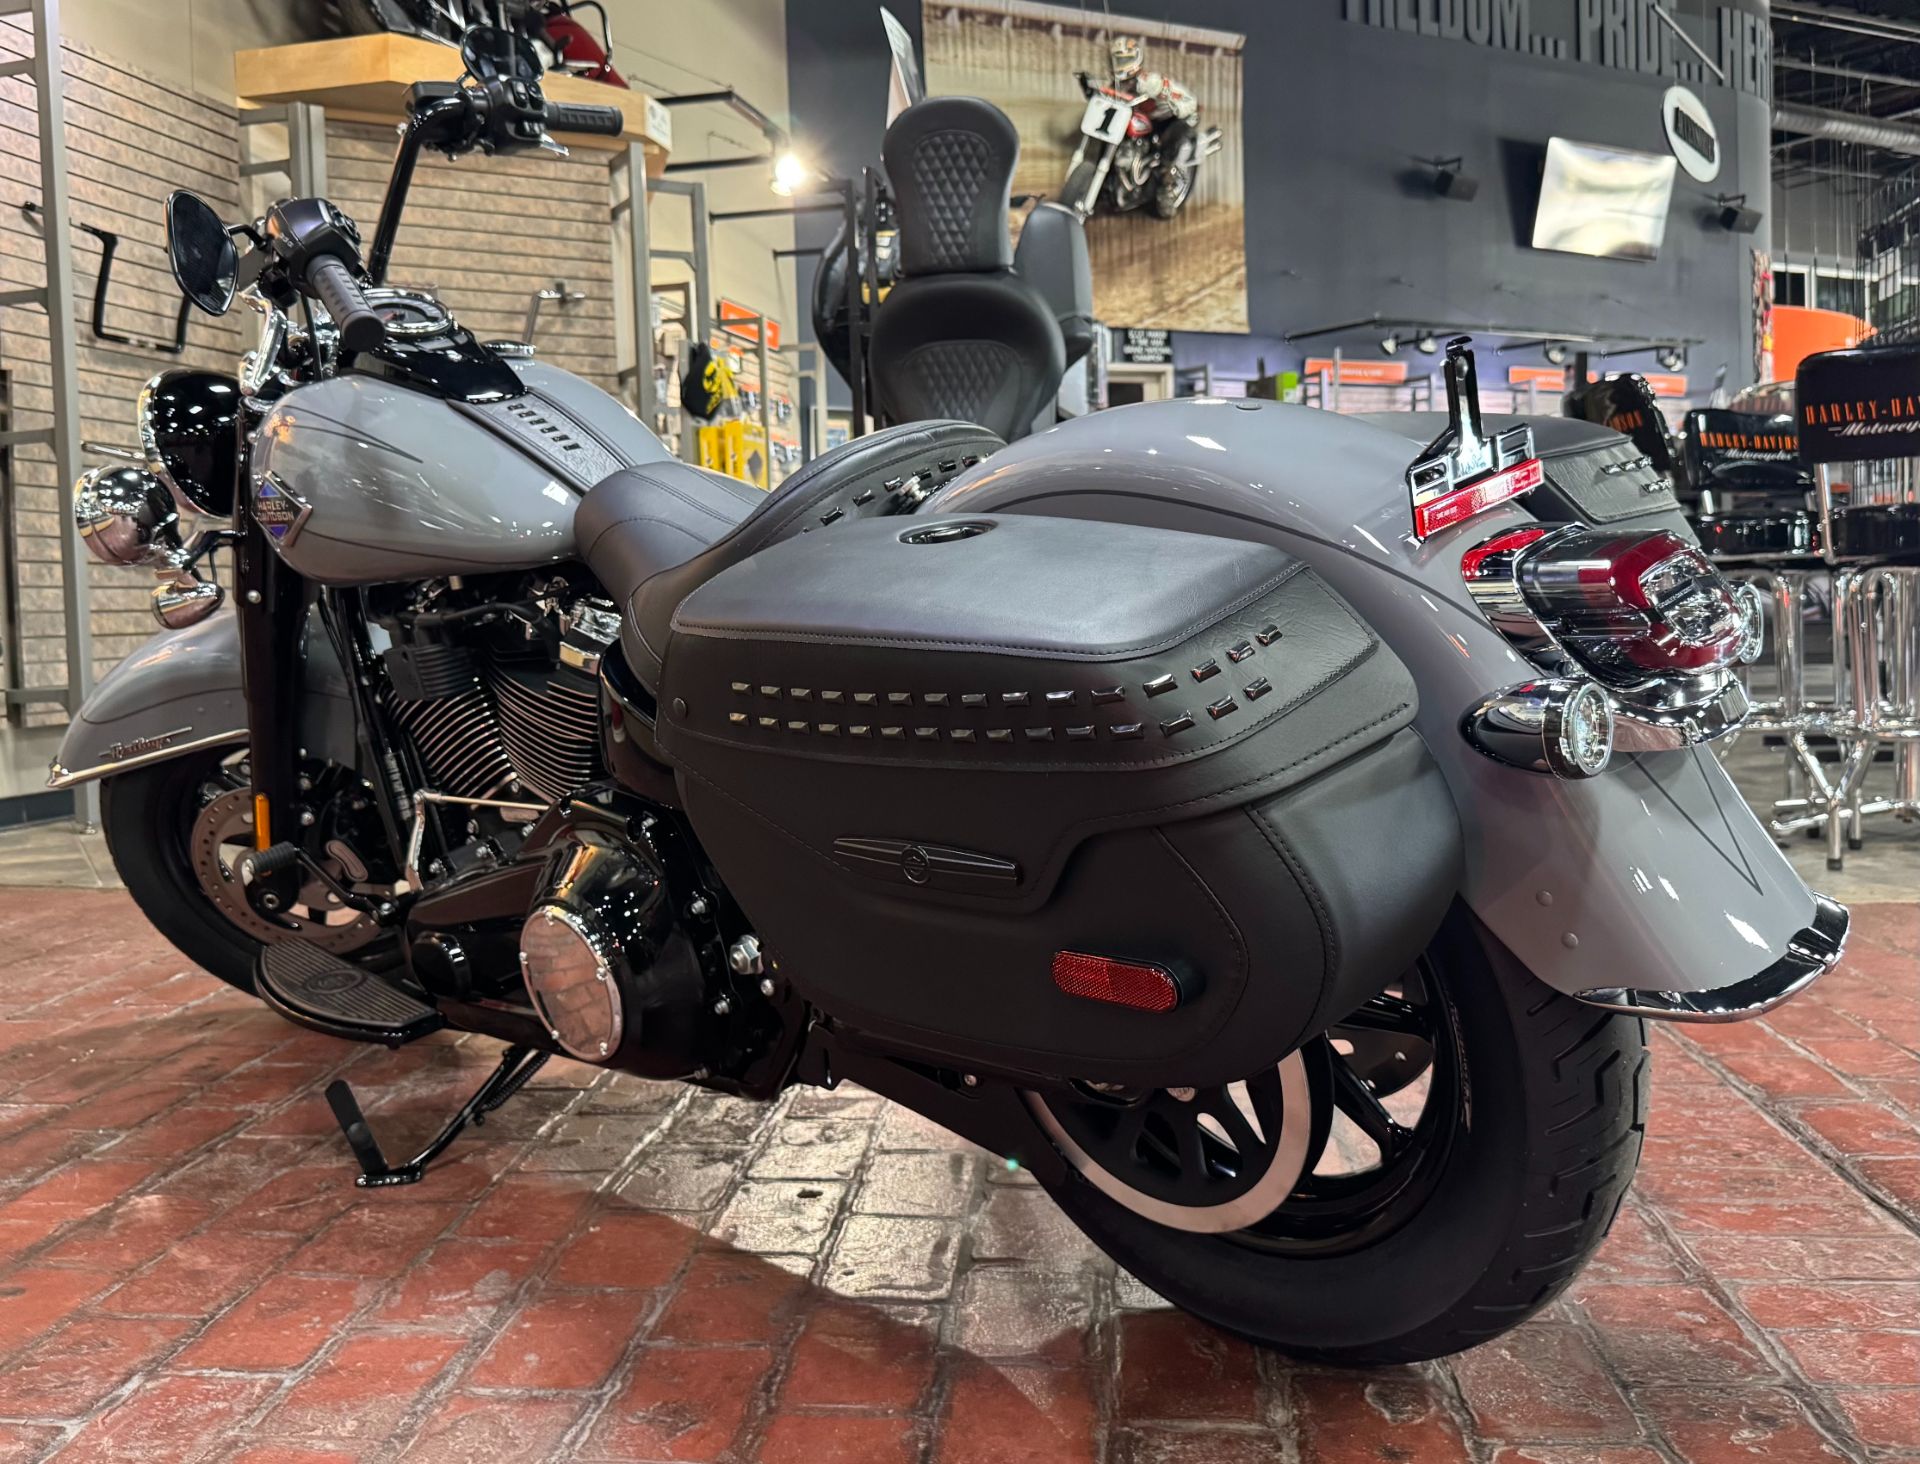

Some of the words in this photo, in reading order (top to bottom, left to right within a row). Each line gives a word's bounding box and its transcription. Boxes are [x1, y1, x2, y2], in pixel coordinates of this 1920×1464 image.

[1095, 107, 1118, 135] 1
[1806, 394, 1920, 426] HARLEY-DA
[1836, 421, 1920, 436] Motorcy
